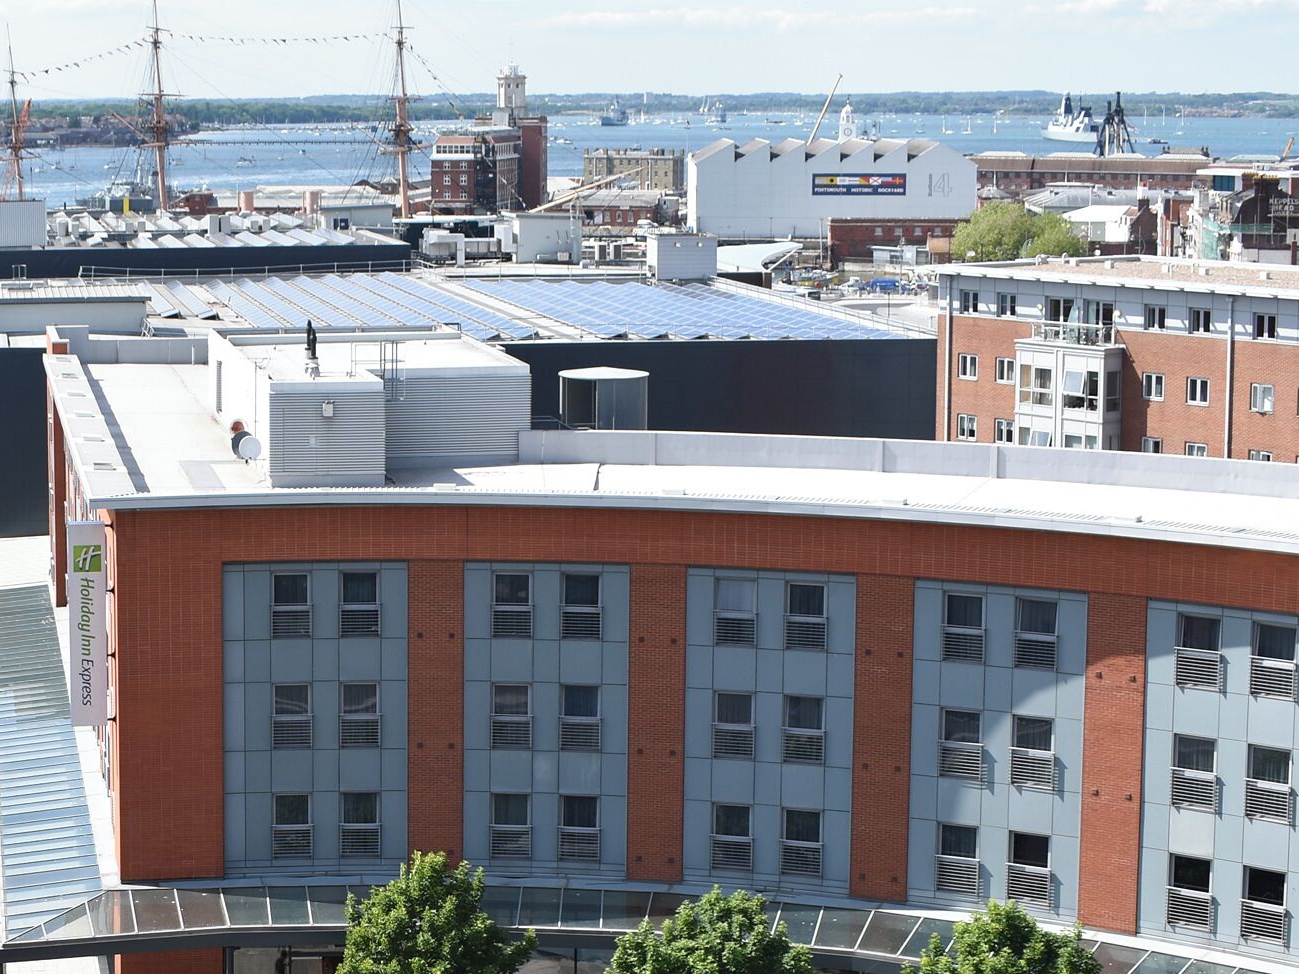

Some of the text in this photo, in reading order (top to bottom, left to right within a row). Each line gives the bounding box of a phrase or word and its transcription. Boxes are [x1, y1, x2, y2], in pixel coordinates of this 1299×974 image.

[78, 577, 96, 706] Holiday Inn Express
